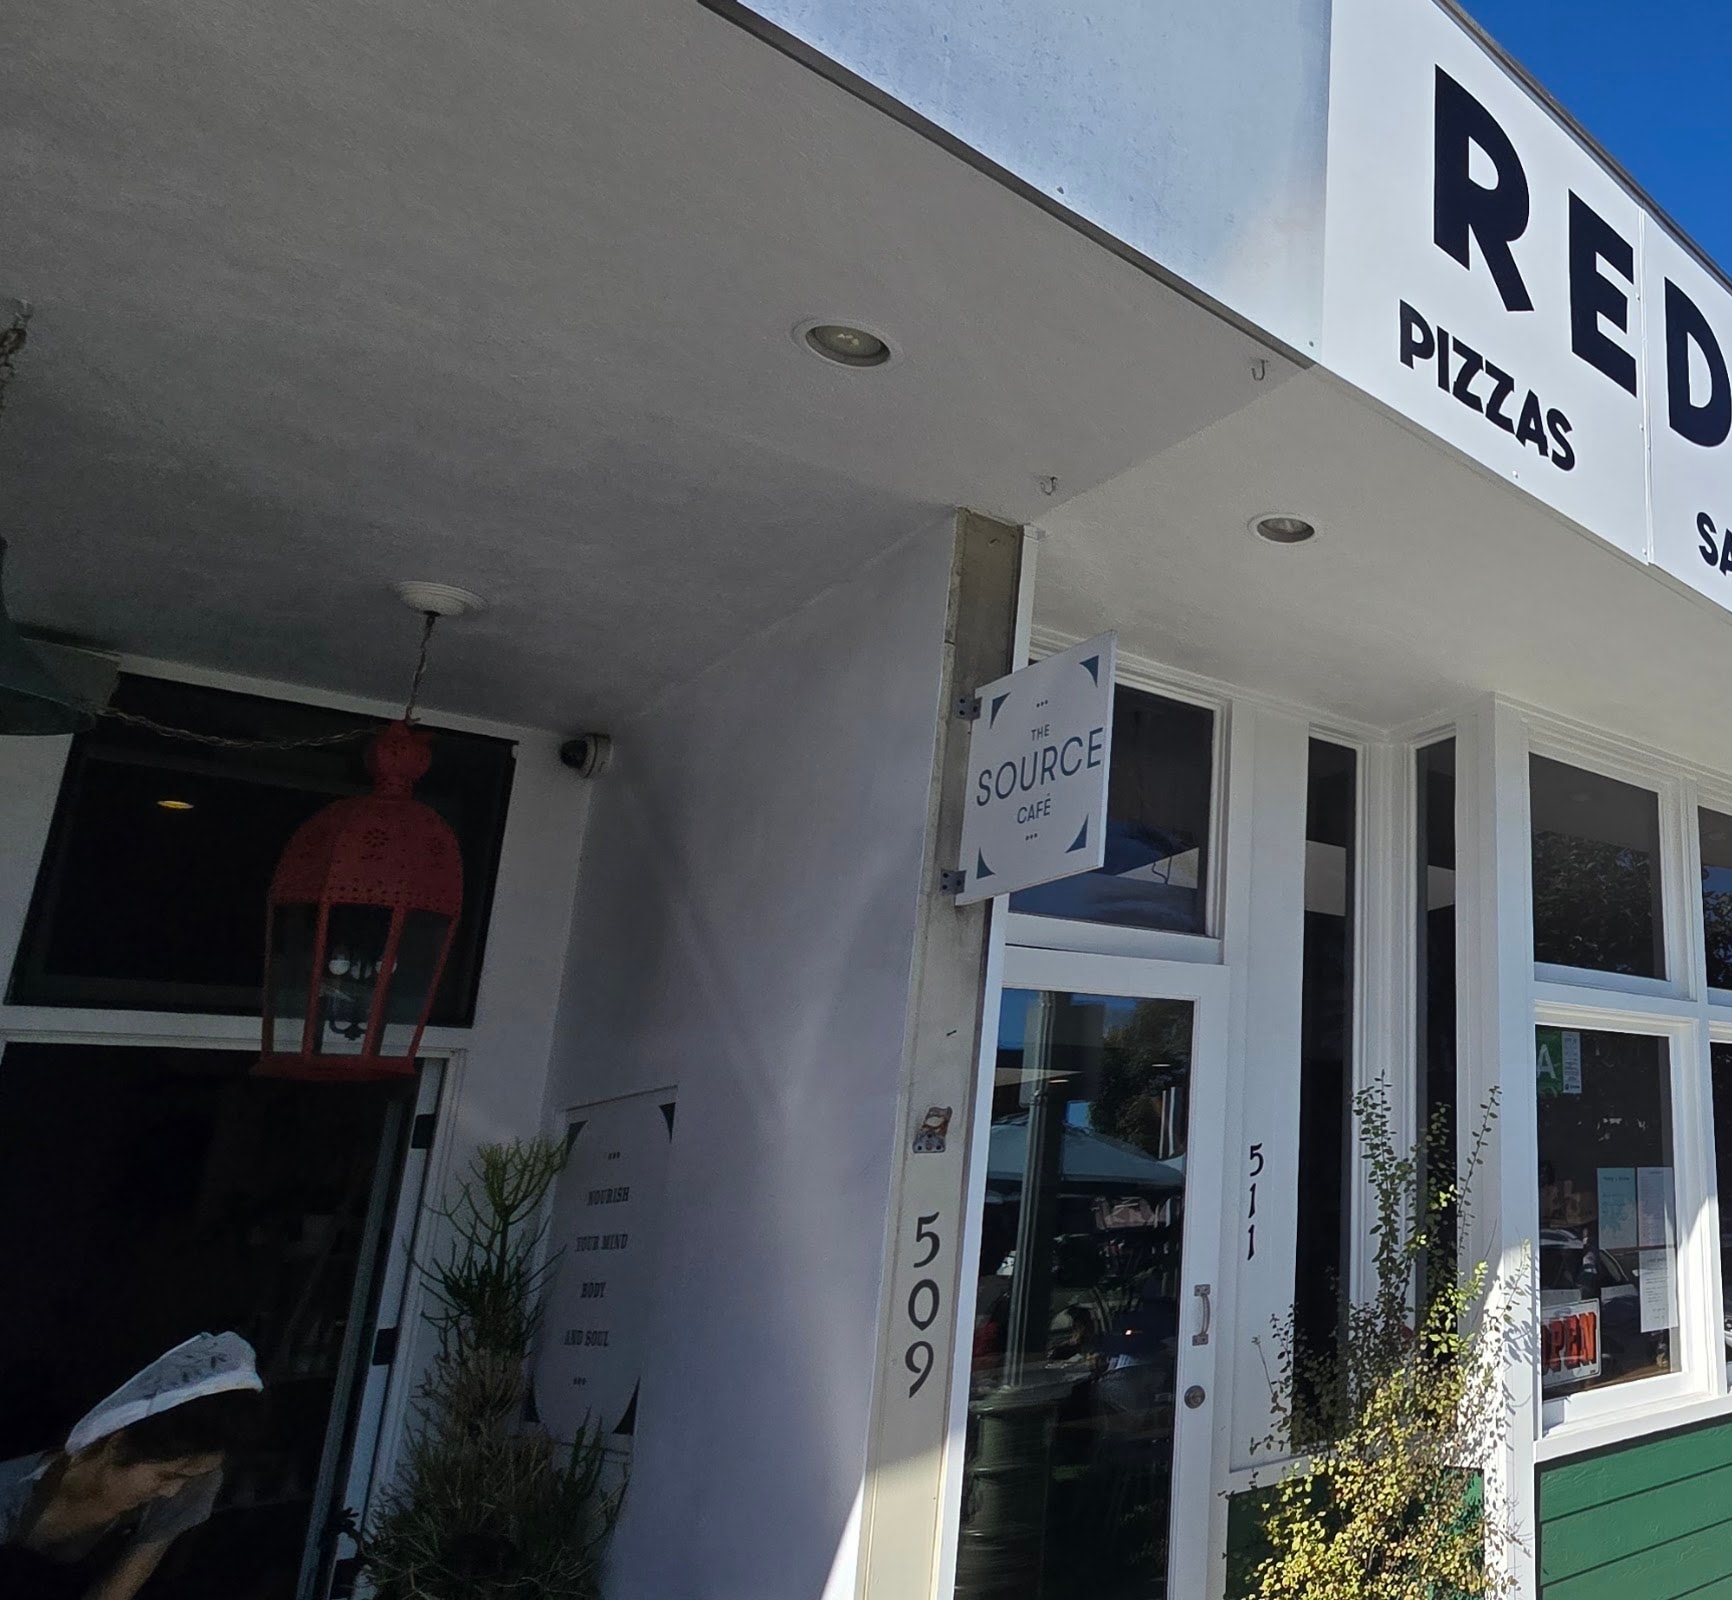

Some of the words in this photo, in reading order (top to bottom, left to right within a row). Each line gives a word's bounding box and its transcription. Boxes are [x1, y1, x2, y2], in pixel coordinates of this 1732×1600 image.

[1399, 299, 1576, 472] PIZZAS
[1031, 724, 1050, 741] THE
[976, 727, 1104, 807] SOURCE
[1017, 793, 1052, 825] CAFÉ
[1536, 1043, 1557, 1079] A
[586, 1186, 630, 1206] NOURISH
[1247, 1142, 1264, 1261] 511
[574, 1235, 600, 1252] YOUR
[601, 1233, 629, 1250] MIND
[580, 1281, 607, 1298] BODY
[904, 1211, 941, 1399] 509
[563, 1329, 584, 1346] AND
[584, 1330, 610, 1347] SOUL
